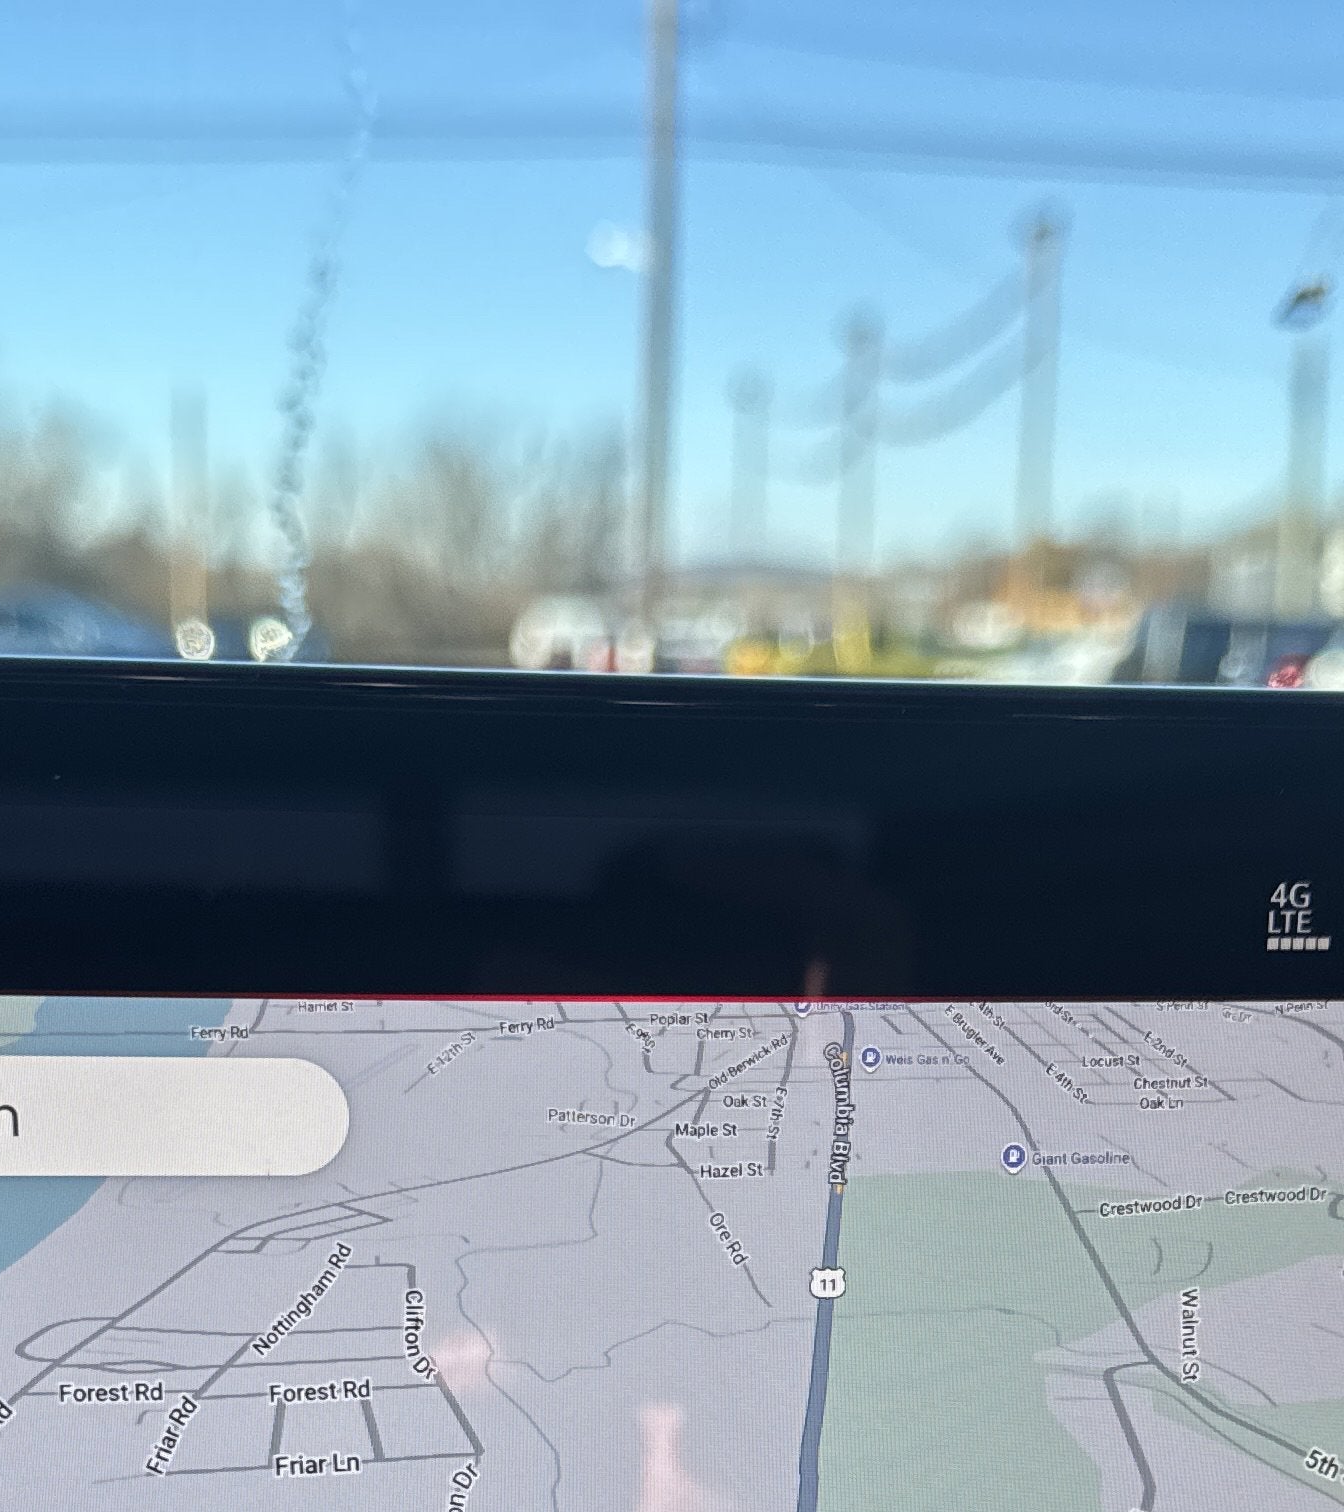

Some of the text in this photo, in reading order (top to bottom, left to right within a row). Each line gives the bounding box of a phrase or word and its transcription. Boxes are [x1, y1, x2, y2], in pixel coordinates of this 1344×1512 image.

[1270, 884, 1310, 908] 4G
[1268, 911, 1311, 934] LTE
[500, 1018, 554, 1034] Ferry Rd
[650, 1013, 708, 1026] Poplar St
[191, 1026, 248, 1042] Ferry Rd
[739, 1027, 751, 1038] St
[984, 1045, 1005, 1065] Ave
[1082, 1055, 1140, 1067] Locust St
[709, 1075, 728, 1090] Old
[1134, 1077, 1208, 1089] Chestnut St
[723, 1095, 767, 1107] Oak St
[1140, 1097, 1165, 1109] Oak
[548, 1110, 635, 1127] Patterson Dr
[824, 1042, 854, 1185] Columbia Blvd
[675, 1124, 737, 1138] Maple St
[1032, 1153, 1130, 1165] Giant Gasoline
[700, 1163, 763, 1177] Hazel St
[1224, 1187, 1327, 1205] Crestwood Dr
[1100, 1194, 1202, 1217] Crestwood Dr
[710, 1213, 746, 1265] Ore Rd
[820, 1279, 836, 1290] 11
[253, 1242, 353, 1356] Nottingham Rd
[403, 1289, 436, 1379] Clifton Dr
[1181, 1289, 1199, 1382] Walnut St
[59, 1383, 162, 1402] Forest Rd
[270, 1380, 370, 1401] Forest Rd
[146, 1396, 197, 1475] Friar Rd
[275, 1454, 359, 1476] Friar Ln
[1305, 1450, 1339, 1478] 5th
[453, 1463, 479, 1490] Dr
